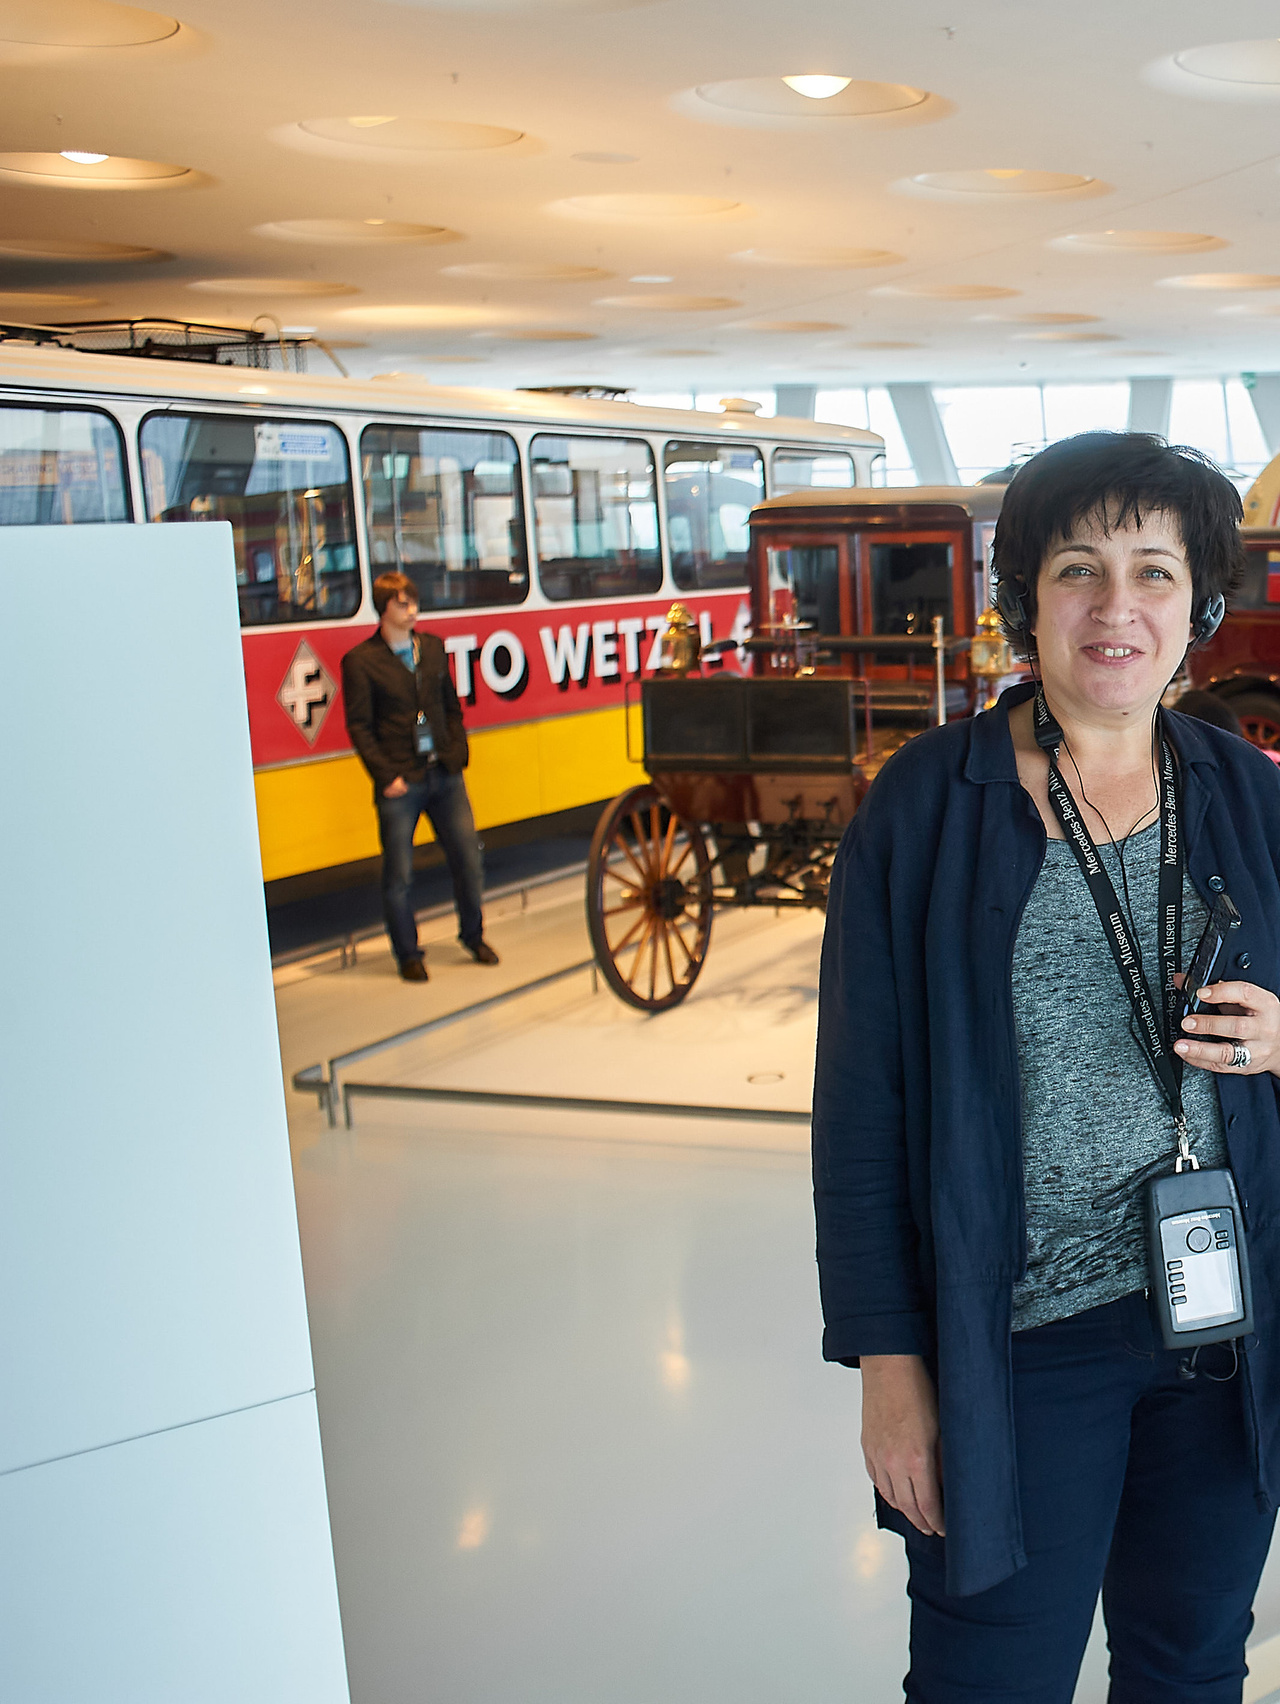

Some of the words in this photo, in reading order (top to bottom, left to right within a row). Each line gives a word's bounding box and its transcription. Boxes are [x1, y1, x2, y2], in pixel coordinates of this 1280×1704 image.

[538, 611, 721, 685] WETZL
[1162, 741, 1176, 781] Museum
[1056, 790, 1101, 876] Mercedes-Benz
[1164, 784, 1178, 866] Mercedes-Benz
[1109, 911, 1135, 966] Museum
[1163, 904, 1176, 957] Museum
[1128, 966, 1164, 1058] Mercedes-Benz
